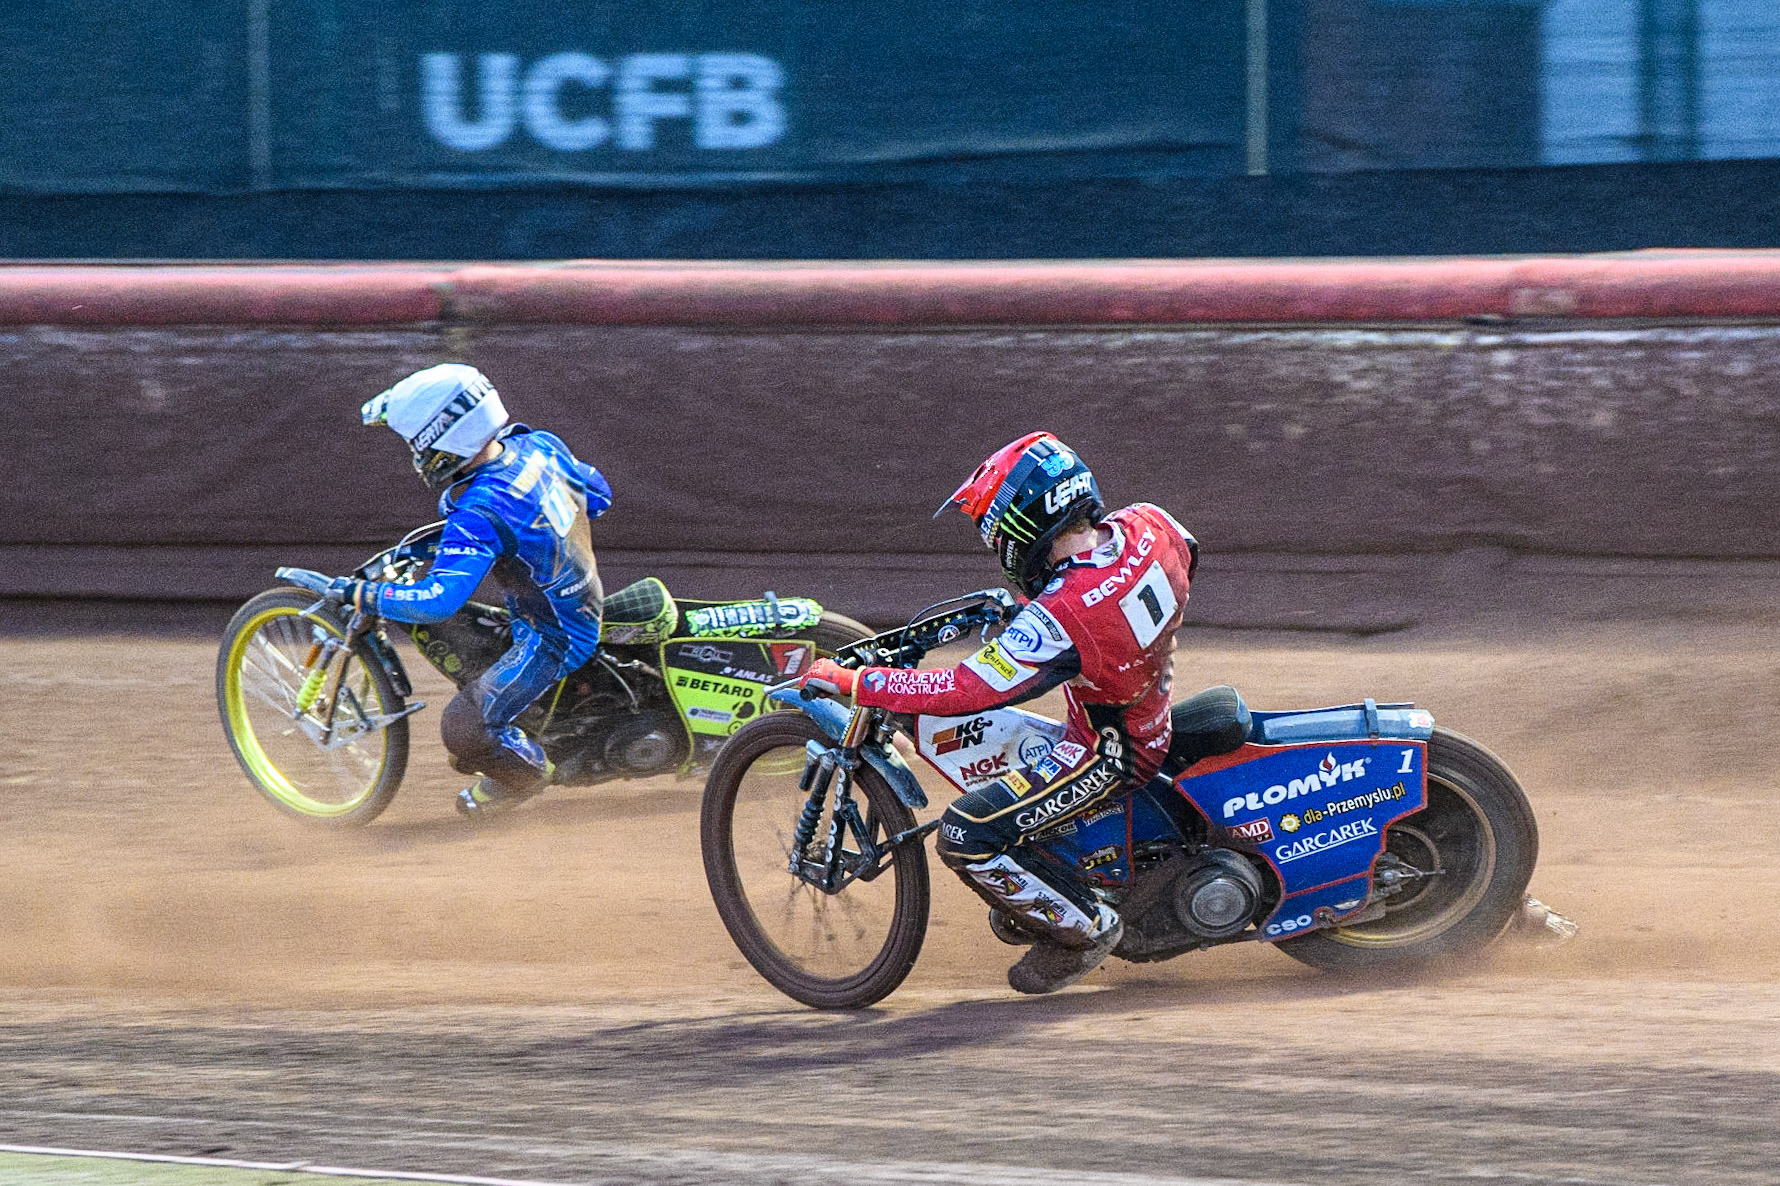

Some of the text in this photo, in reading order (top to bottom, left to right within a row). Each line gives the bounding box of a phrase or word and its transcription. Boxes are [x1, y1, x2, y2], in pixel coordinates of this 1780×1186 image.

[421, 51, 786, 151] UCFB
[1081, 526, 1157, 607] BEWLEY
[1137, 584, 1164, 627] 1
[784, 647, 806, 674] 1
[689, 678, 754, 698] BETARD
[888, 669, 954, 684] KRAJEWKI
[1025, 743, 1049, 760] ATPI
[1397, 749, 1414, 773] 1
[960, 752, 1008, 781] NGK
[1016, 764, 1115, 828] GARCAREK
[1223, 757, 1366, 818] PŁOMYK
[1232, 821, 1269, 838] AMD
[1275, 817, 1377, 861] GARCAREK
[1266, 914, 1313, 935] CSO
